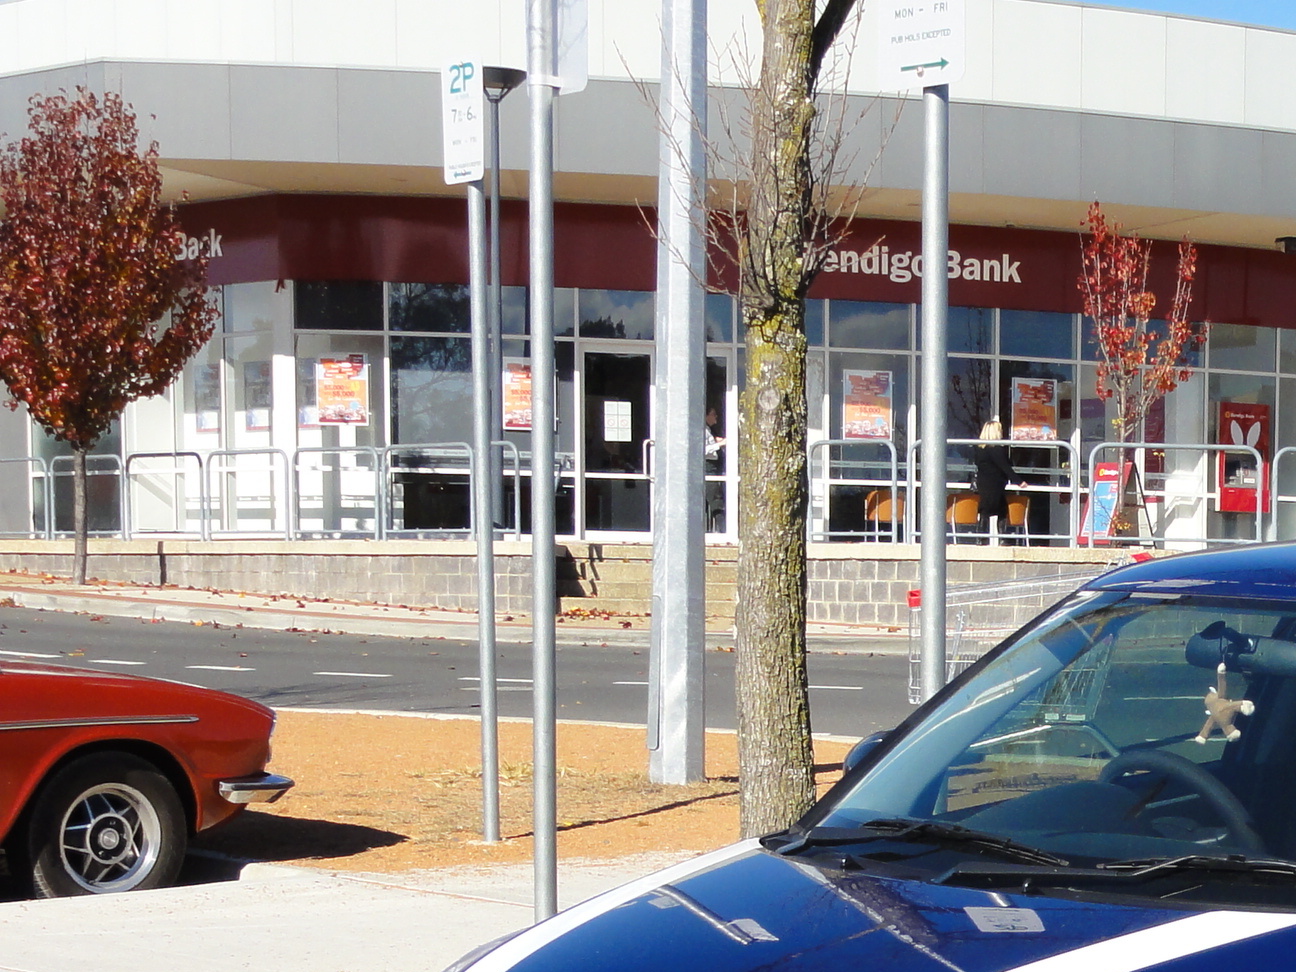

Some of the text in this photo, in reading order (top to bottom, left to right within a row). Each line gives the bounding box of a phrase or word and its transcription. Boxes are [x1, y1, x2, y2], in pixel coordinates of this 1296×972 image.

[894, 8, 914, 19] MON
[934, 2, 948, 13] FRI
[922, 28, 951, 40] EXCEPTED
[449, 62, 475, 94] 2P
